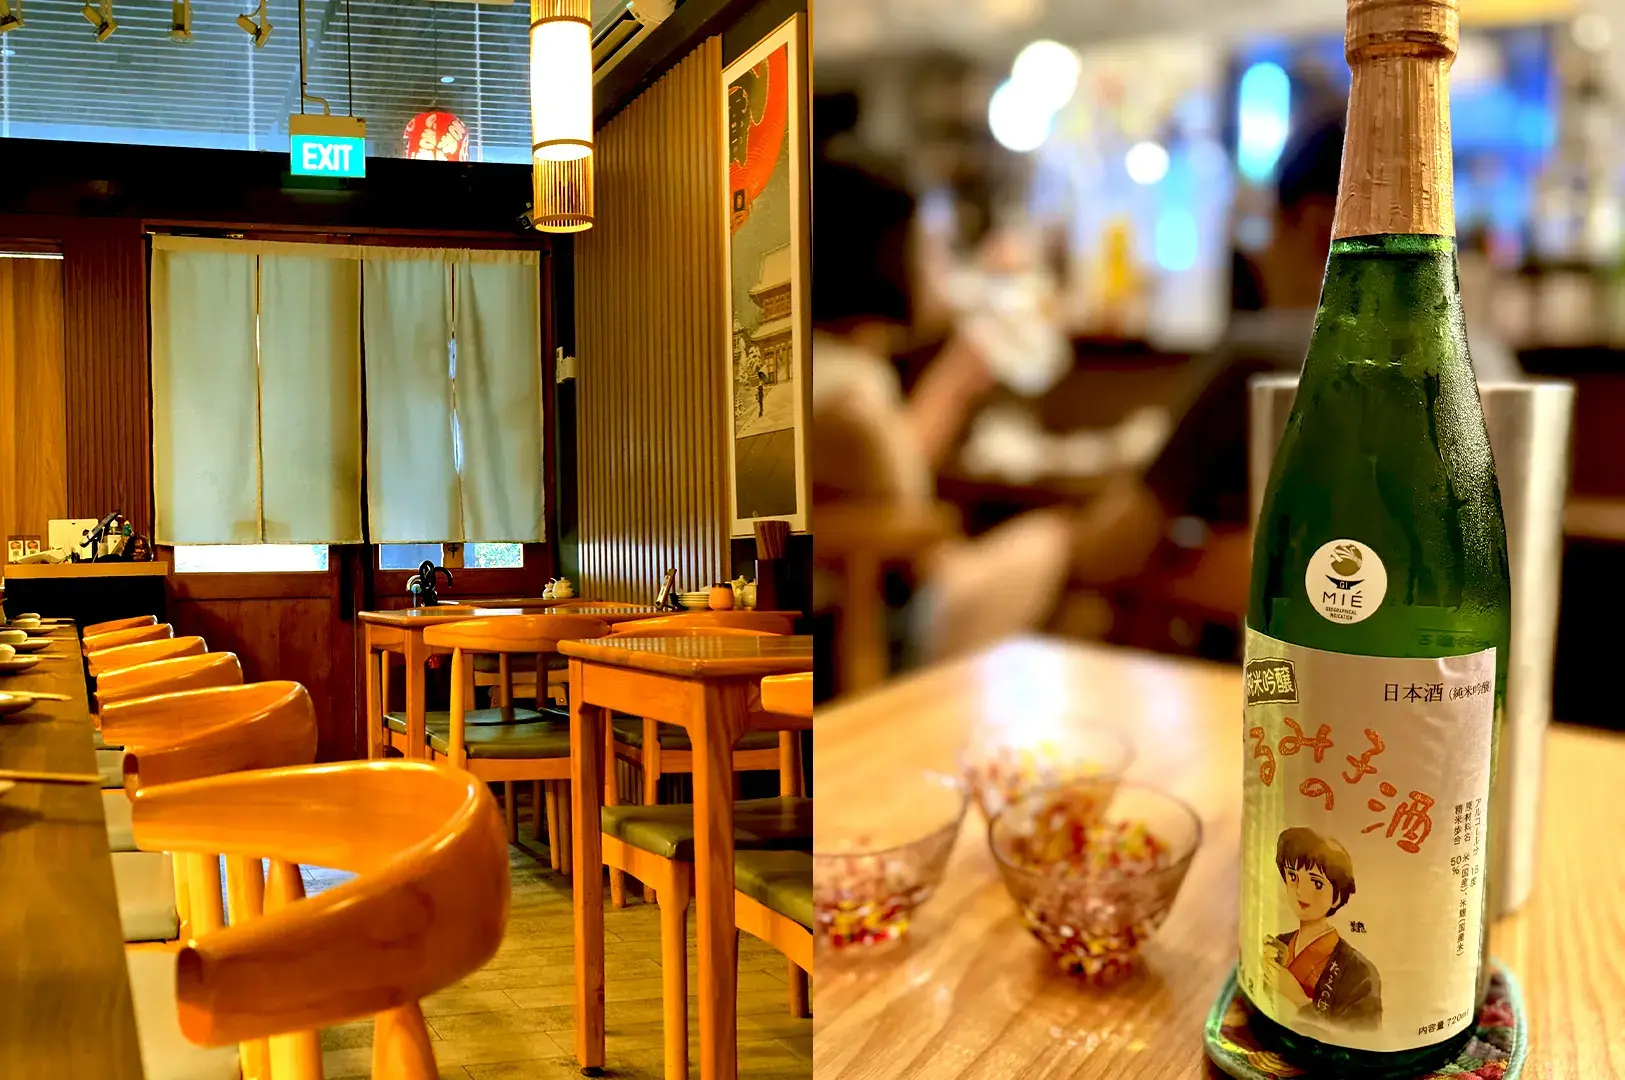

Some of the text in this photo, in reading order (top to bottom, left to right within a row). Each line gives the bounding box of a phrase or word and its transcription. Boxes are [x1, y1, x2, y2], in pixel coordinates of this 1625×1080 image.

[302, 142, 353, 171] EXIT
[1322, 590, 1363, 608] MIÉ
[1384, 682, 1443, 703] 日本酒
[1418, 1020, 1444, 1035] 内容量
